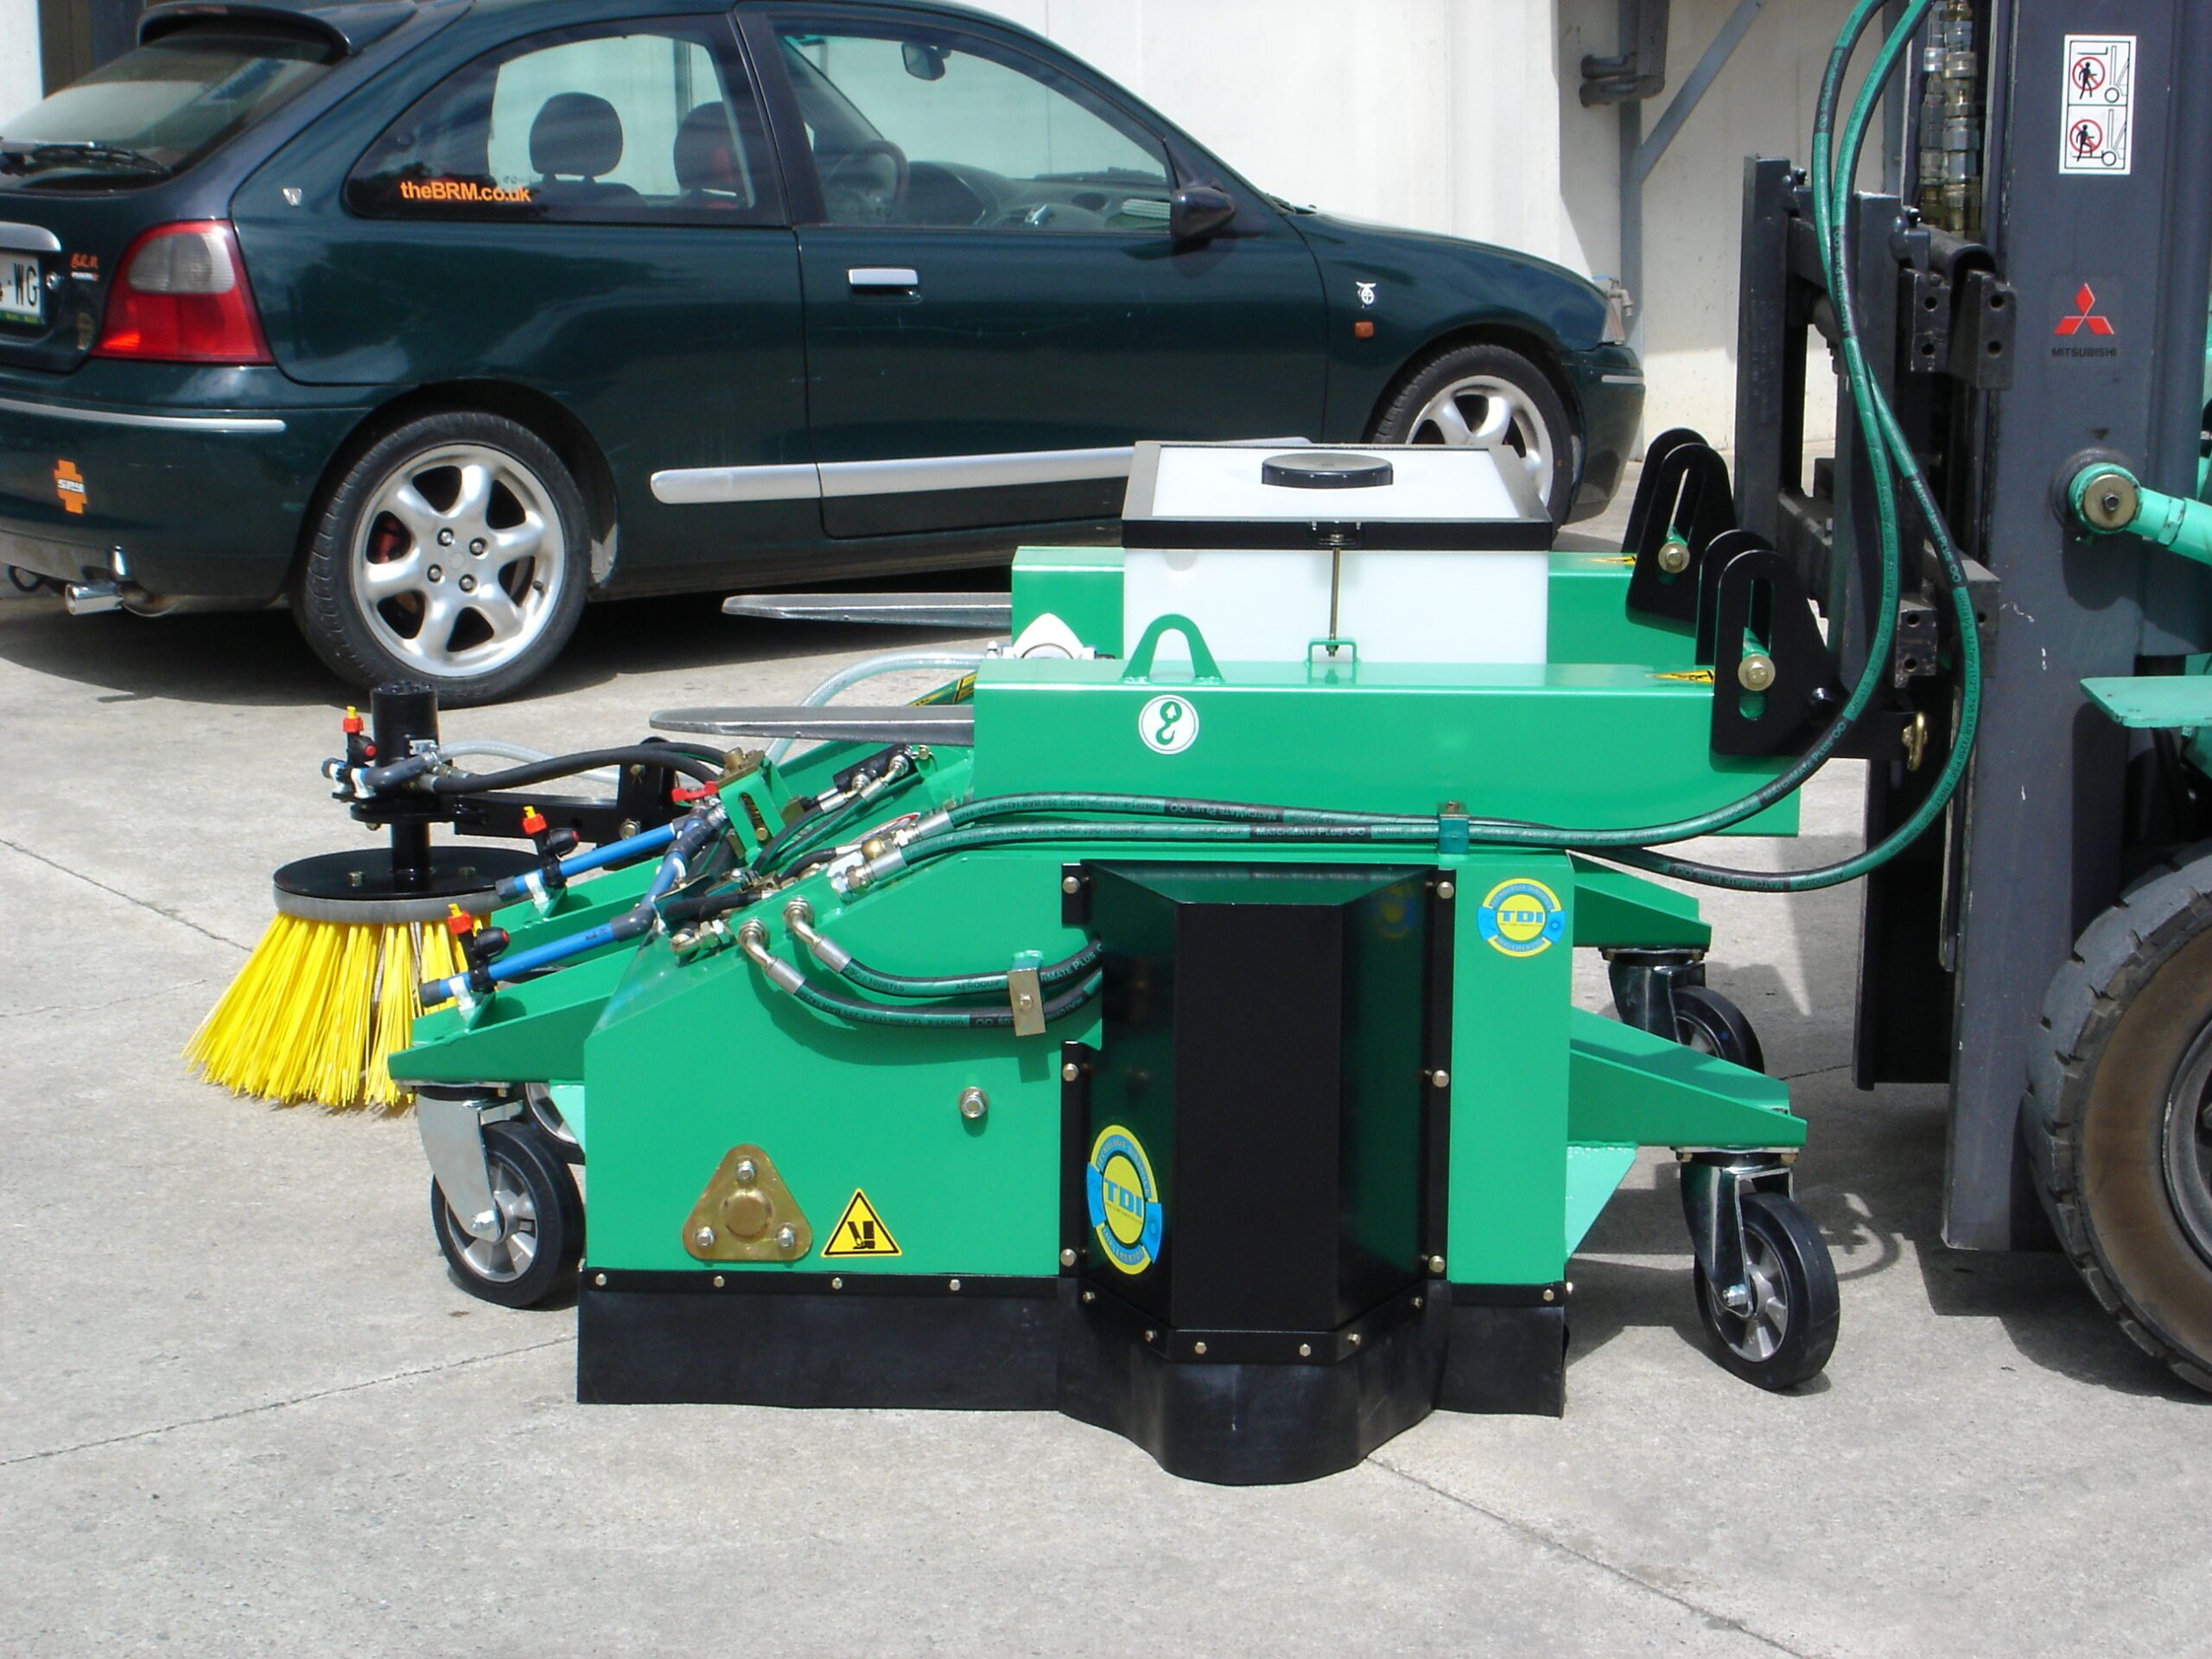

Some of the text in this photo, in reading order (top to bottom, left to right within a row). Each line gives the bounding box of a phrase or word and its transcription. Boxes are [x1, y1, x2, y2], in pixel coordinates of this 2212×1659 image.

[400, 181, 531, 202] theBRM.co.uk
[2051, 347, 2117, 357] MITSUBISHI
[1255, 827, 1317, 837] MATCHMATE
[1318, 827, 1344, 836] PLUS
[1498, 910, 1544, 923] TDI
[955, 980, 1002, 990] AEROQUIP
[1071, 951, 1097, 971] PLUS
[1104, 1179, 1143, 1219] TDI
